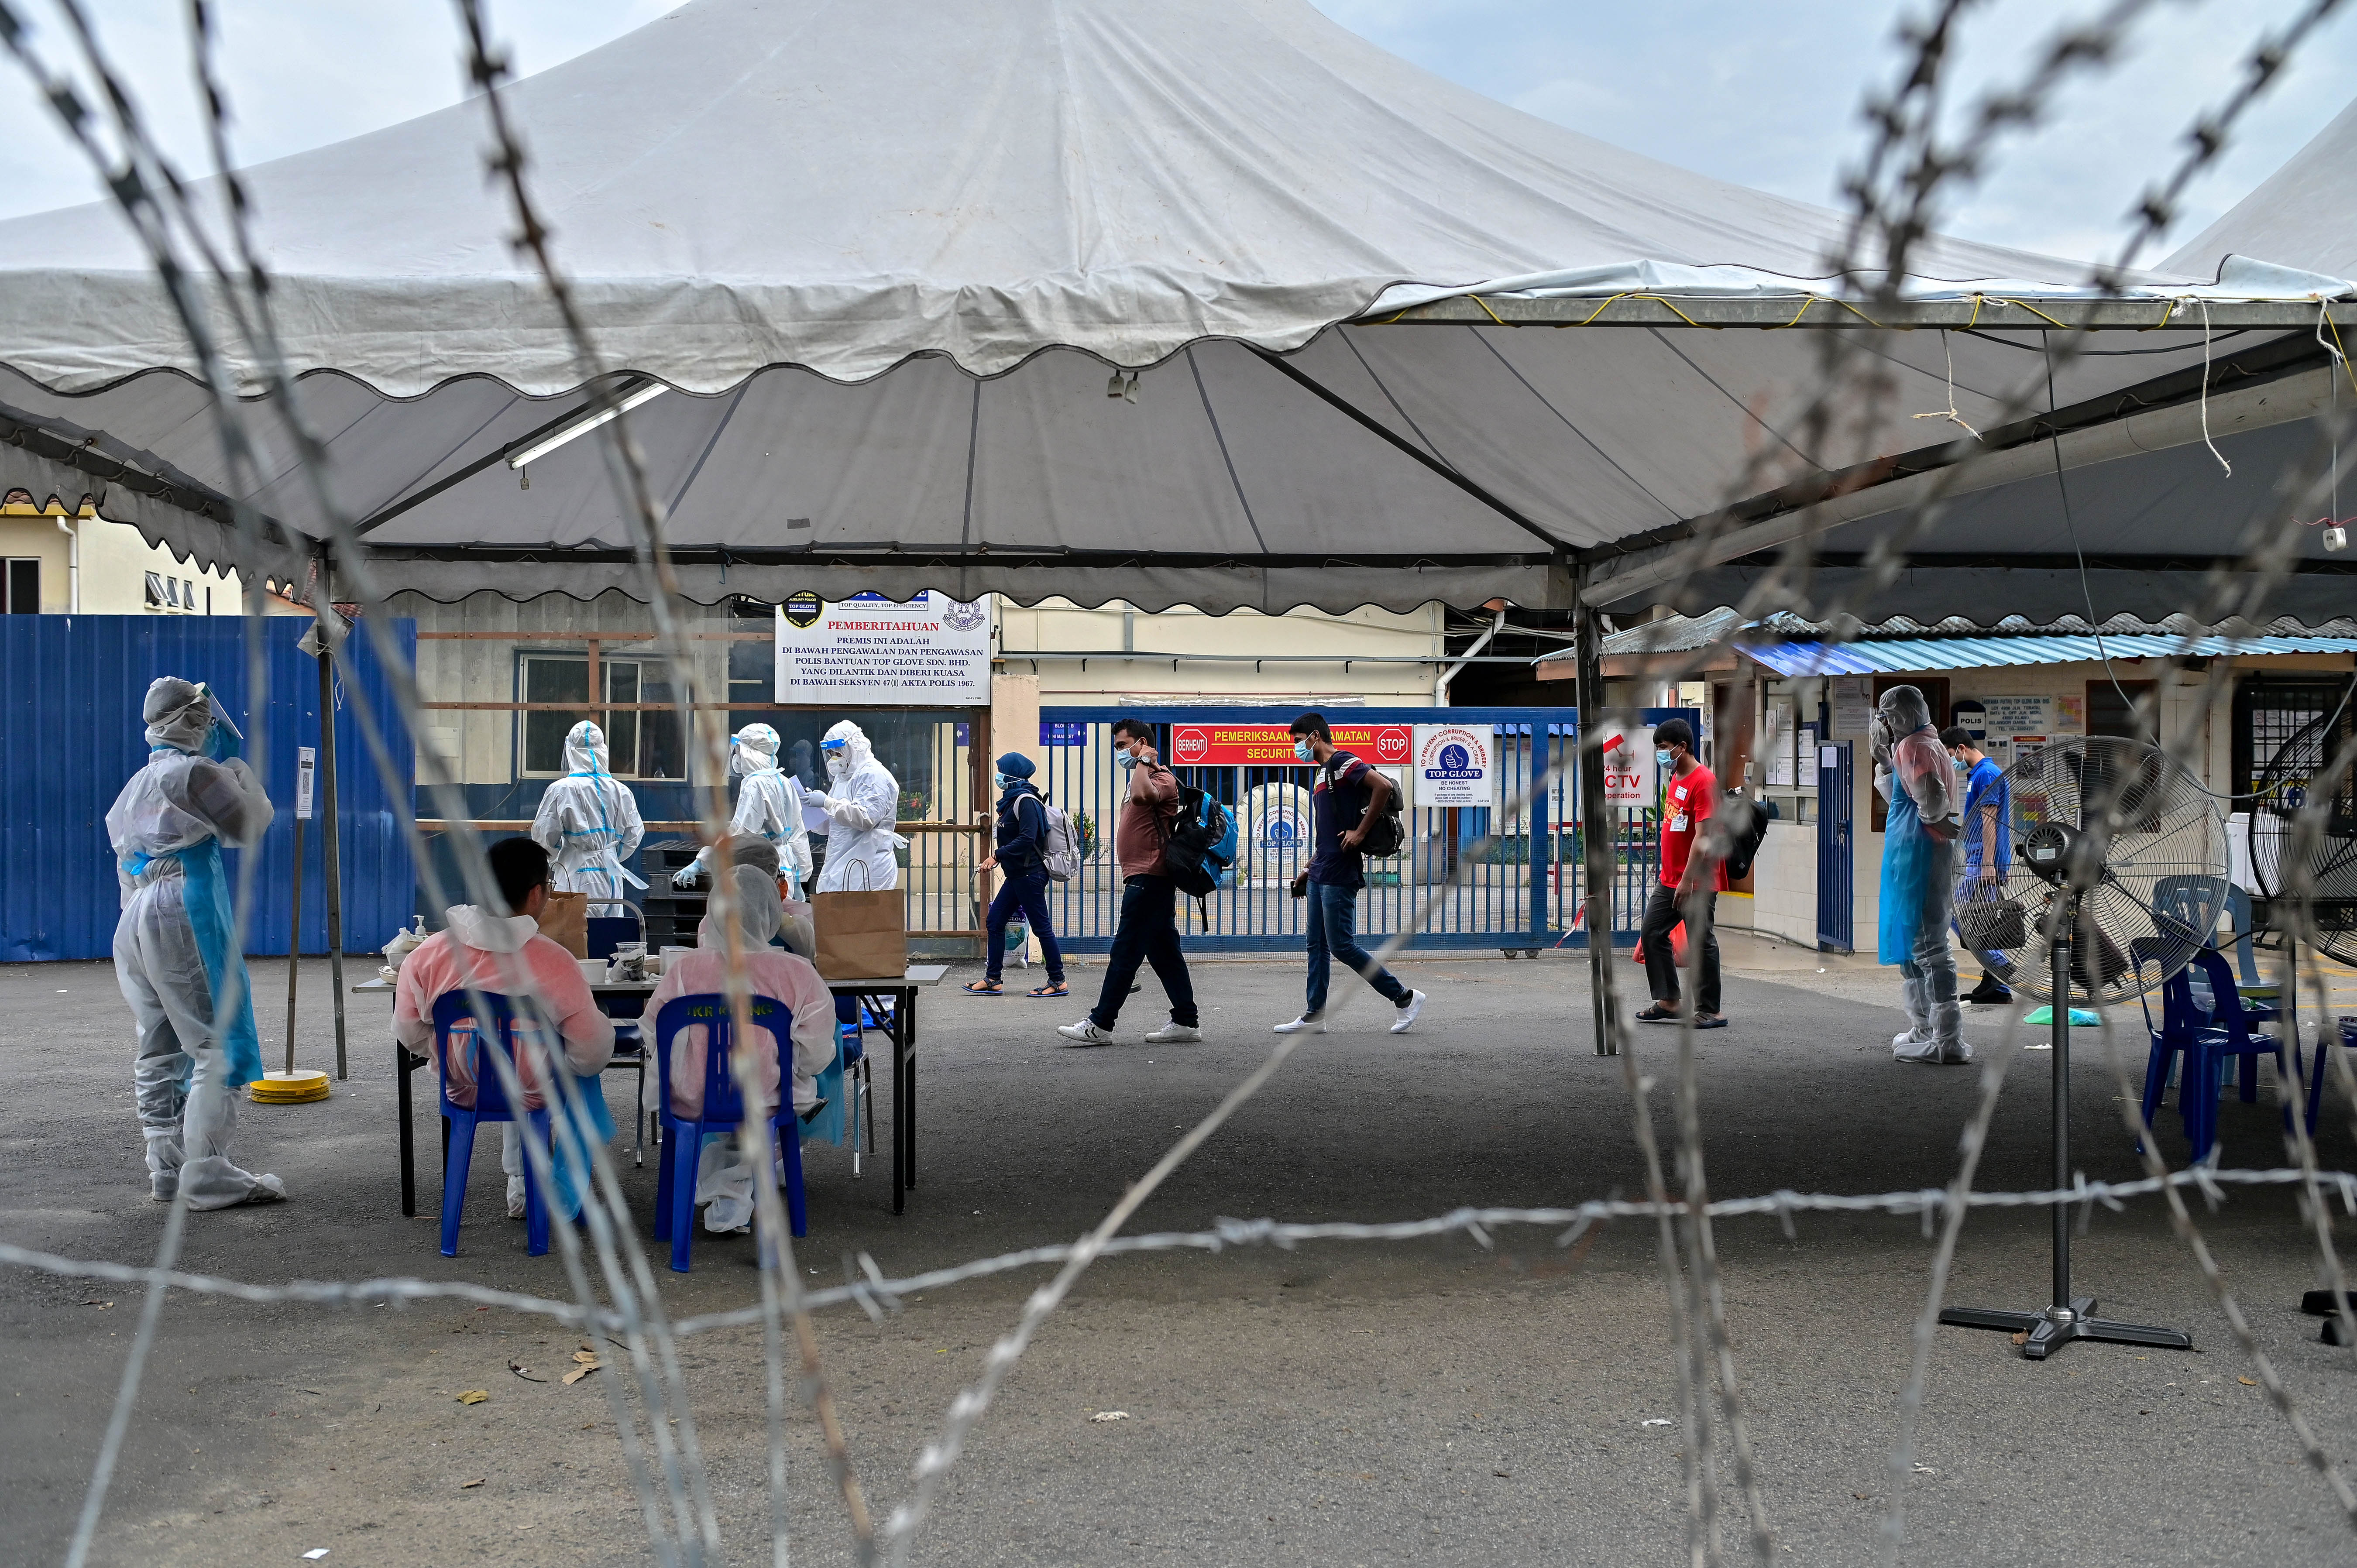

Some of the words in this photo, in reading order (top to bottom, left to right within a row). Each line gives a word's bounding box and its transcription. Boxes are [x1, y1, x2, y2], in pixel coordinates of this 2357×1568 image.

[828, 621, 939, 631] PEMBERITAHUAN
[966, 620, 982, 630] MALAYSIA
[883, 679, 898, 688] 47(1)
[1215, 731, 1291, 741] PEMERIKSAAN
[1330, 731, 1370, 741] AMATAN
[1438, 729, 1475, 741] CORRUPTION
[1178, 739, 1205, 751] BERHENTI
[1380, 738, 1405, 750] STOP
[1422, 734, 1438, 757] PREVENT
[1429, 739, 1445, 765] CORRUPTION
[1478, 745, 1487, 768] BRIBERY
[1421, 759, 1426, 768] TO
[1605, 775, 1641, 788] CTV
